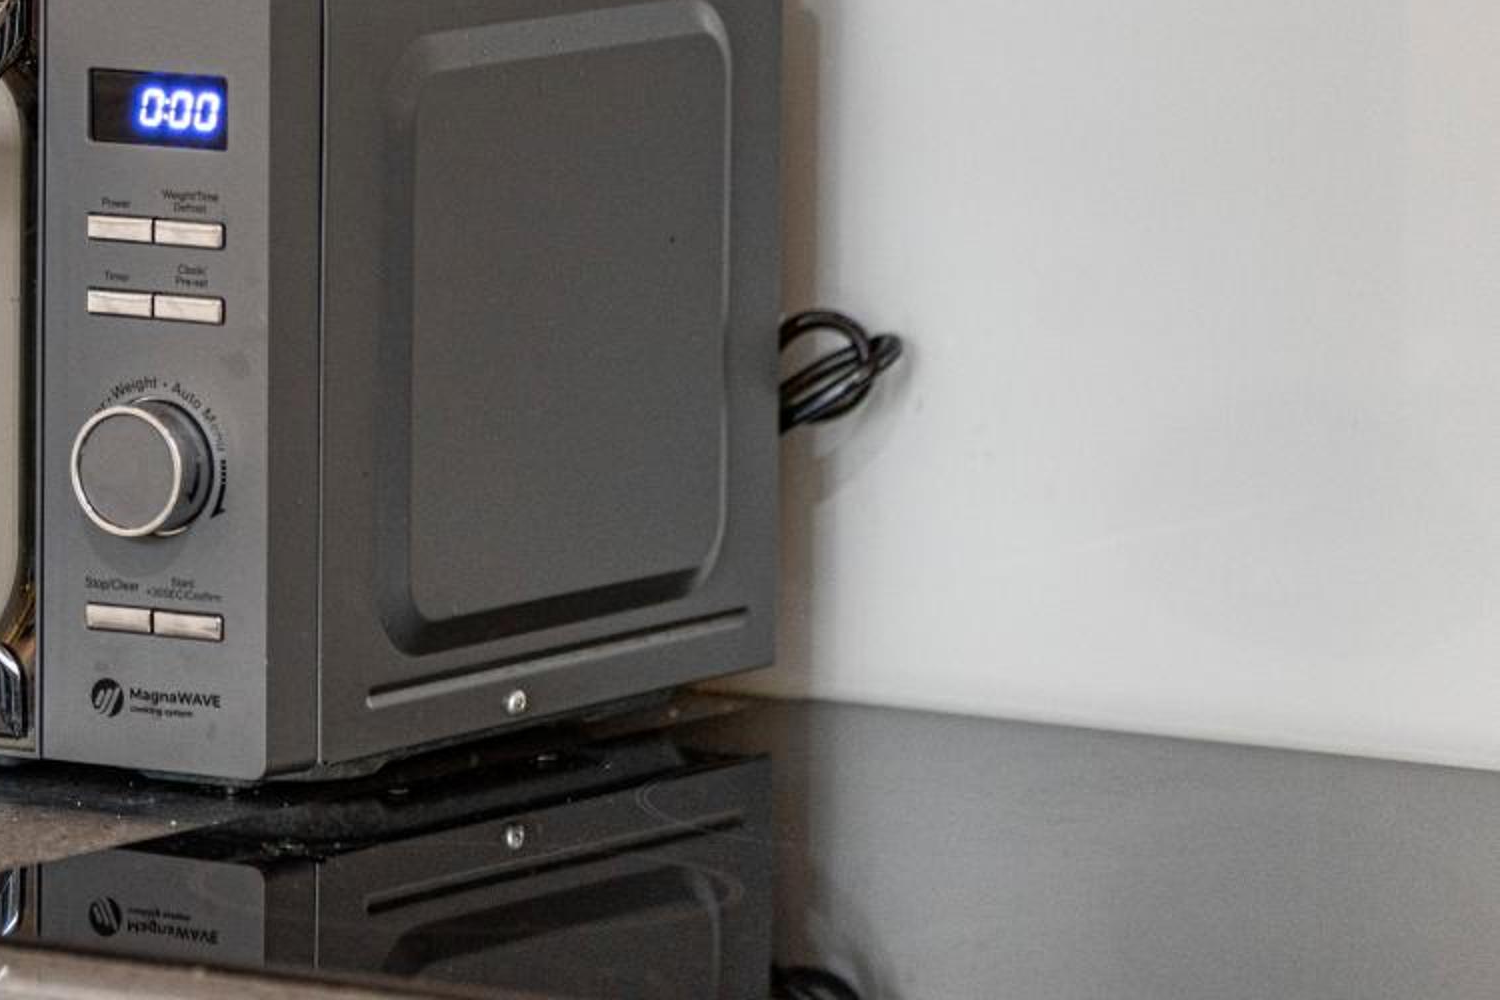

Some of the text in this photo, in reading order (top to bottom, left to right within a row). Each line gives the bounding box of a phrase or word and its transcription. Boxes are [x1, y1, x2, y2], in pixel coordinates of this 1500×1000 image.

[138, 87, 221, 133] 0:00
[109, 375, 157, 399] Weight
[171, 382, 202, 410] Auto
[129, 687, 221, 709] MagnaWAVE
